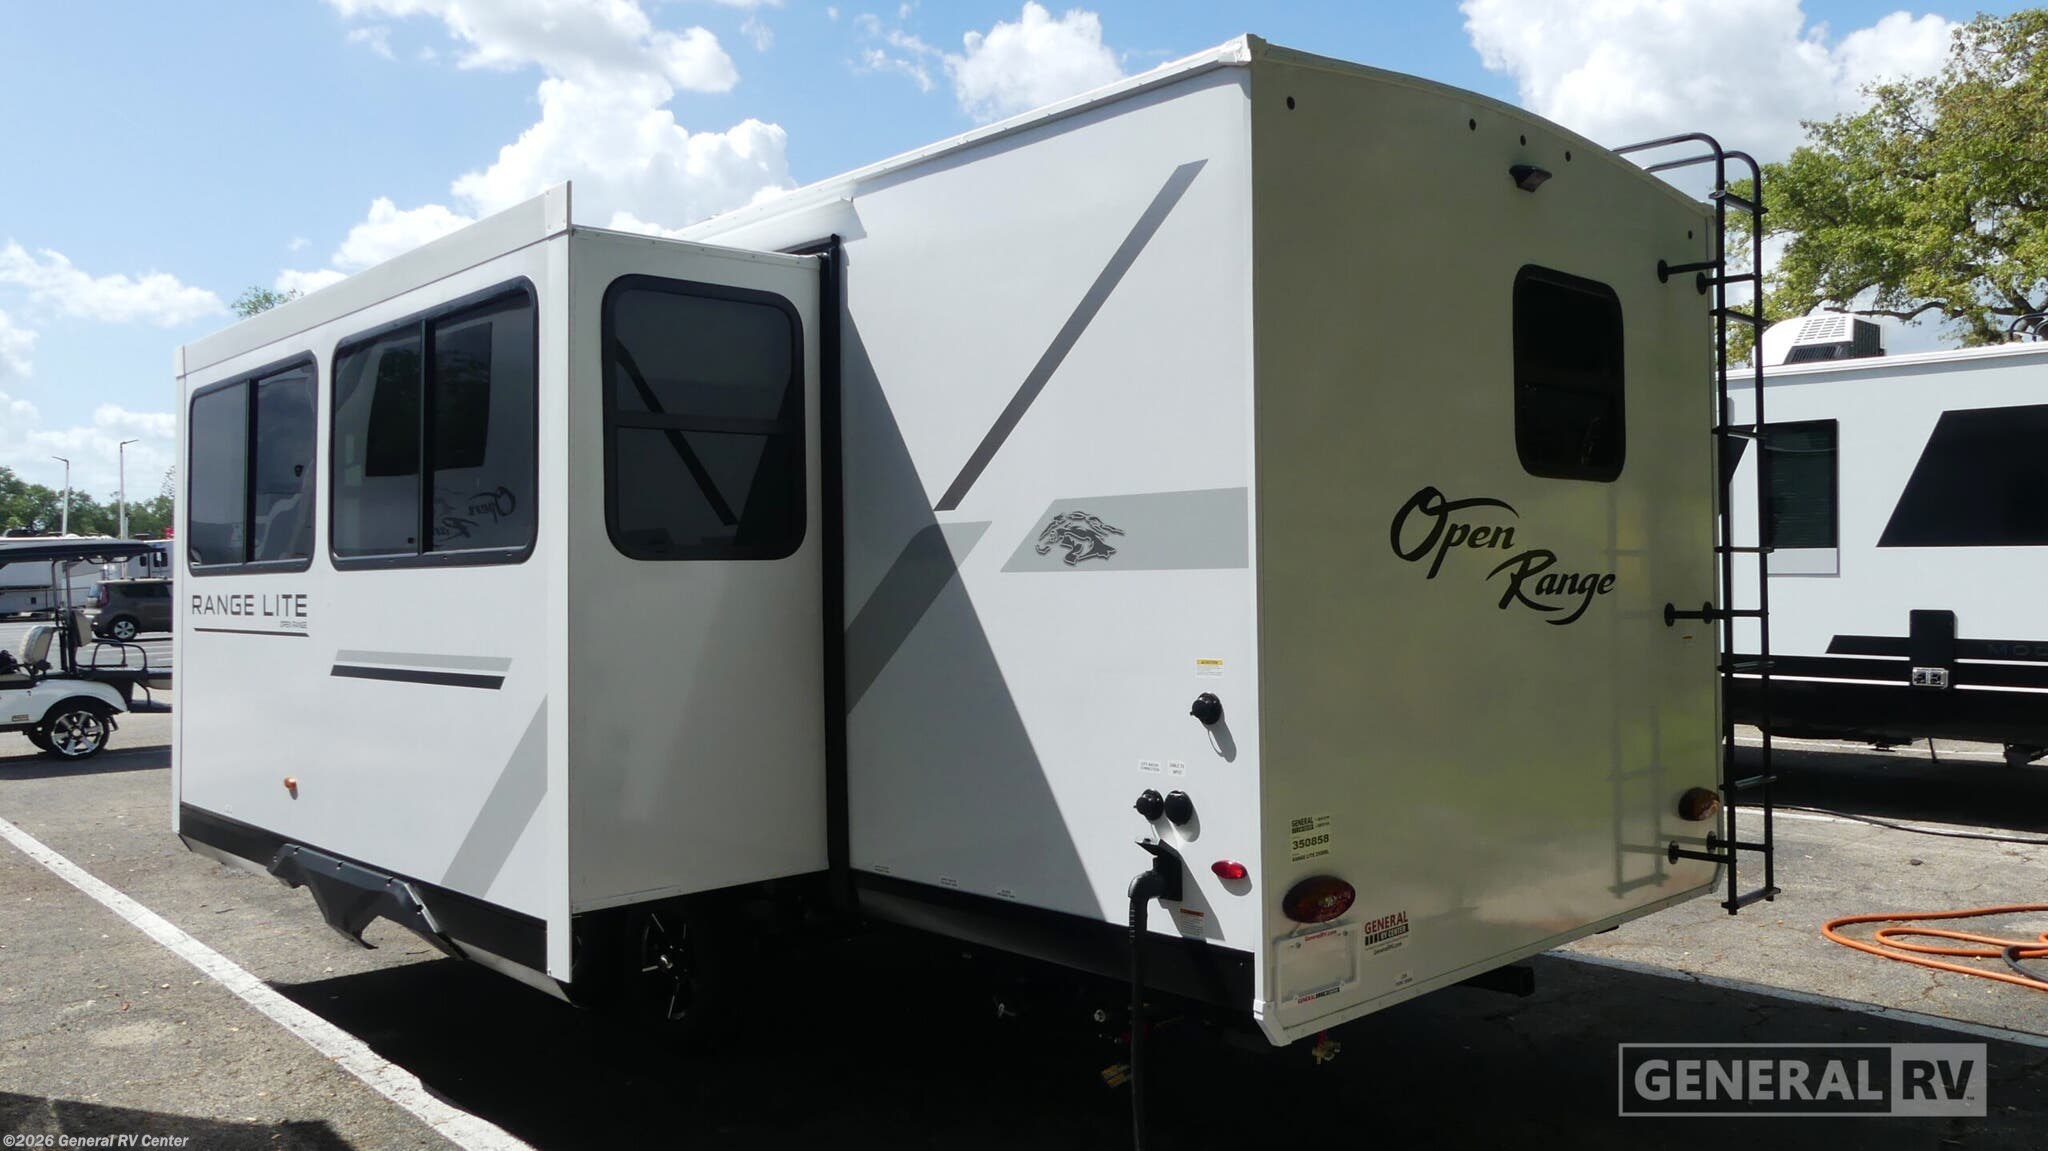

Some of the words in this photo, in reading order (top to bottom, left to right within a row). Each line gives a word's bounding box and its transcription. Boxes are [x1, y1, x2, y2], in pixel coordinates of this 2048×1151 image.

[1391, 486, 1520, 580] Open
[1485, 549, 1616, 625] Range
[192, 594, 254, 616] RANGE
[263, 594, 307, 617] LITE
[1292, 834, 1329, 850] 350858
[1364, 911, 1408, 934] GENERAL
